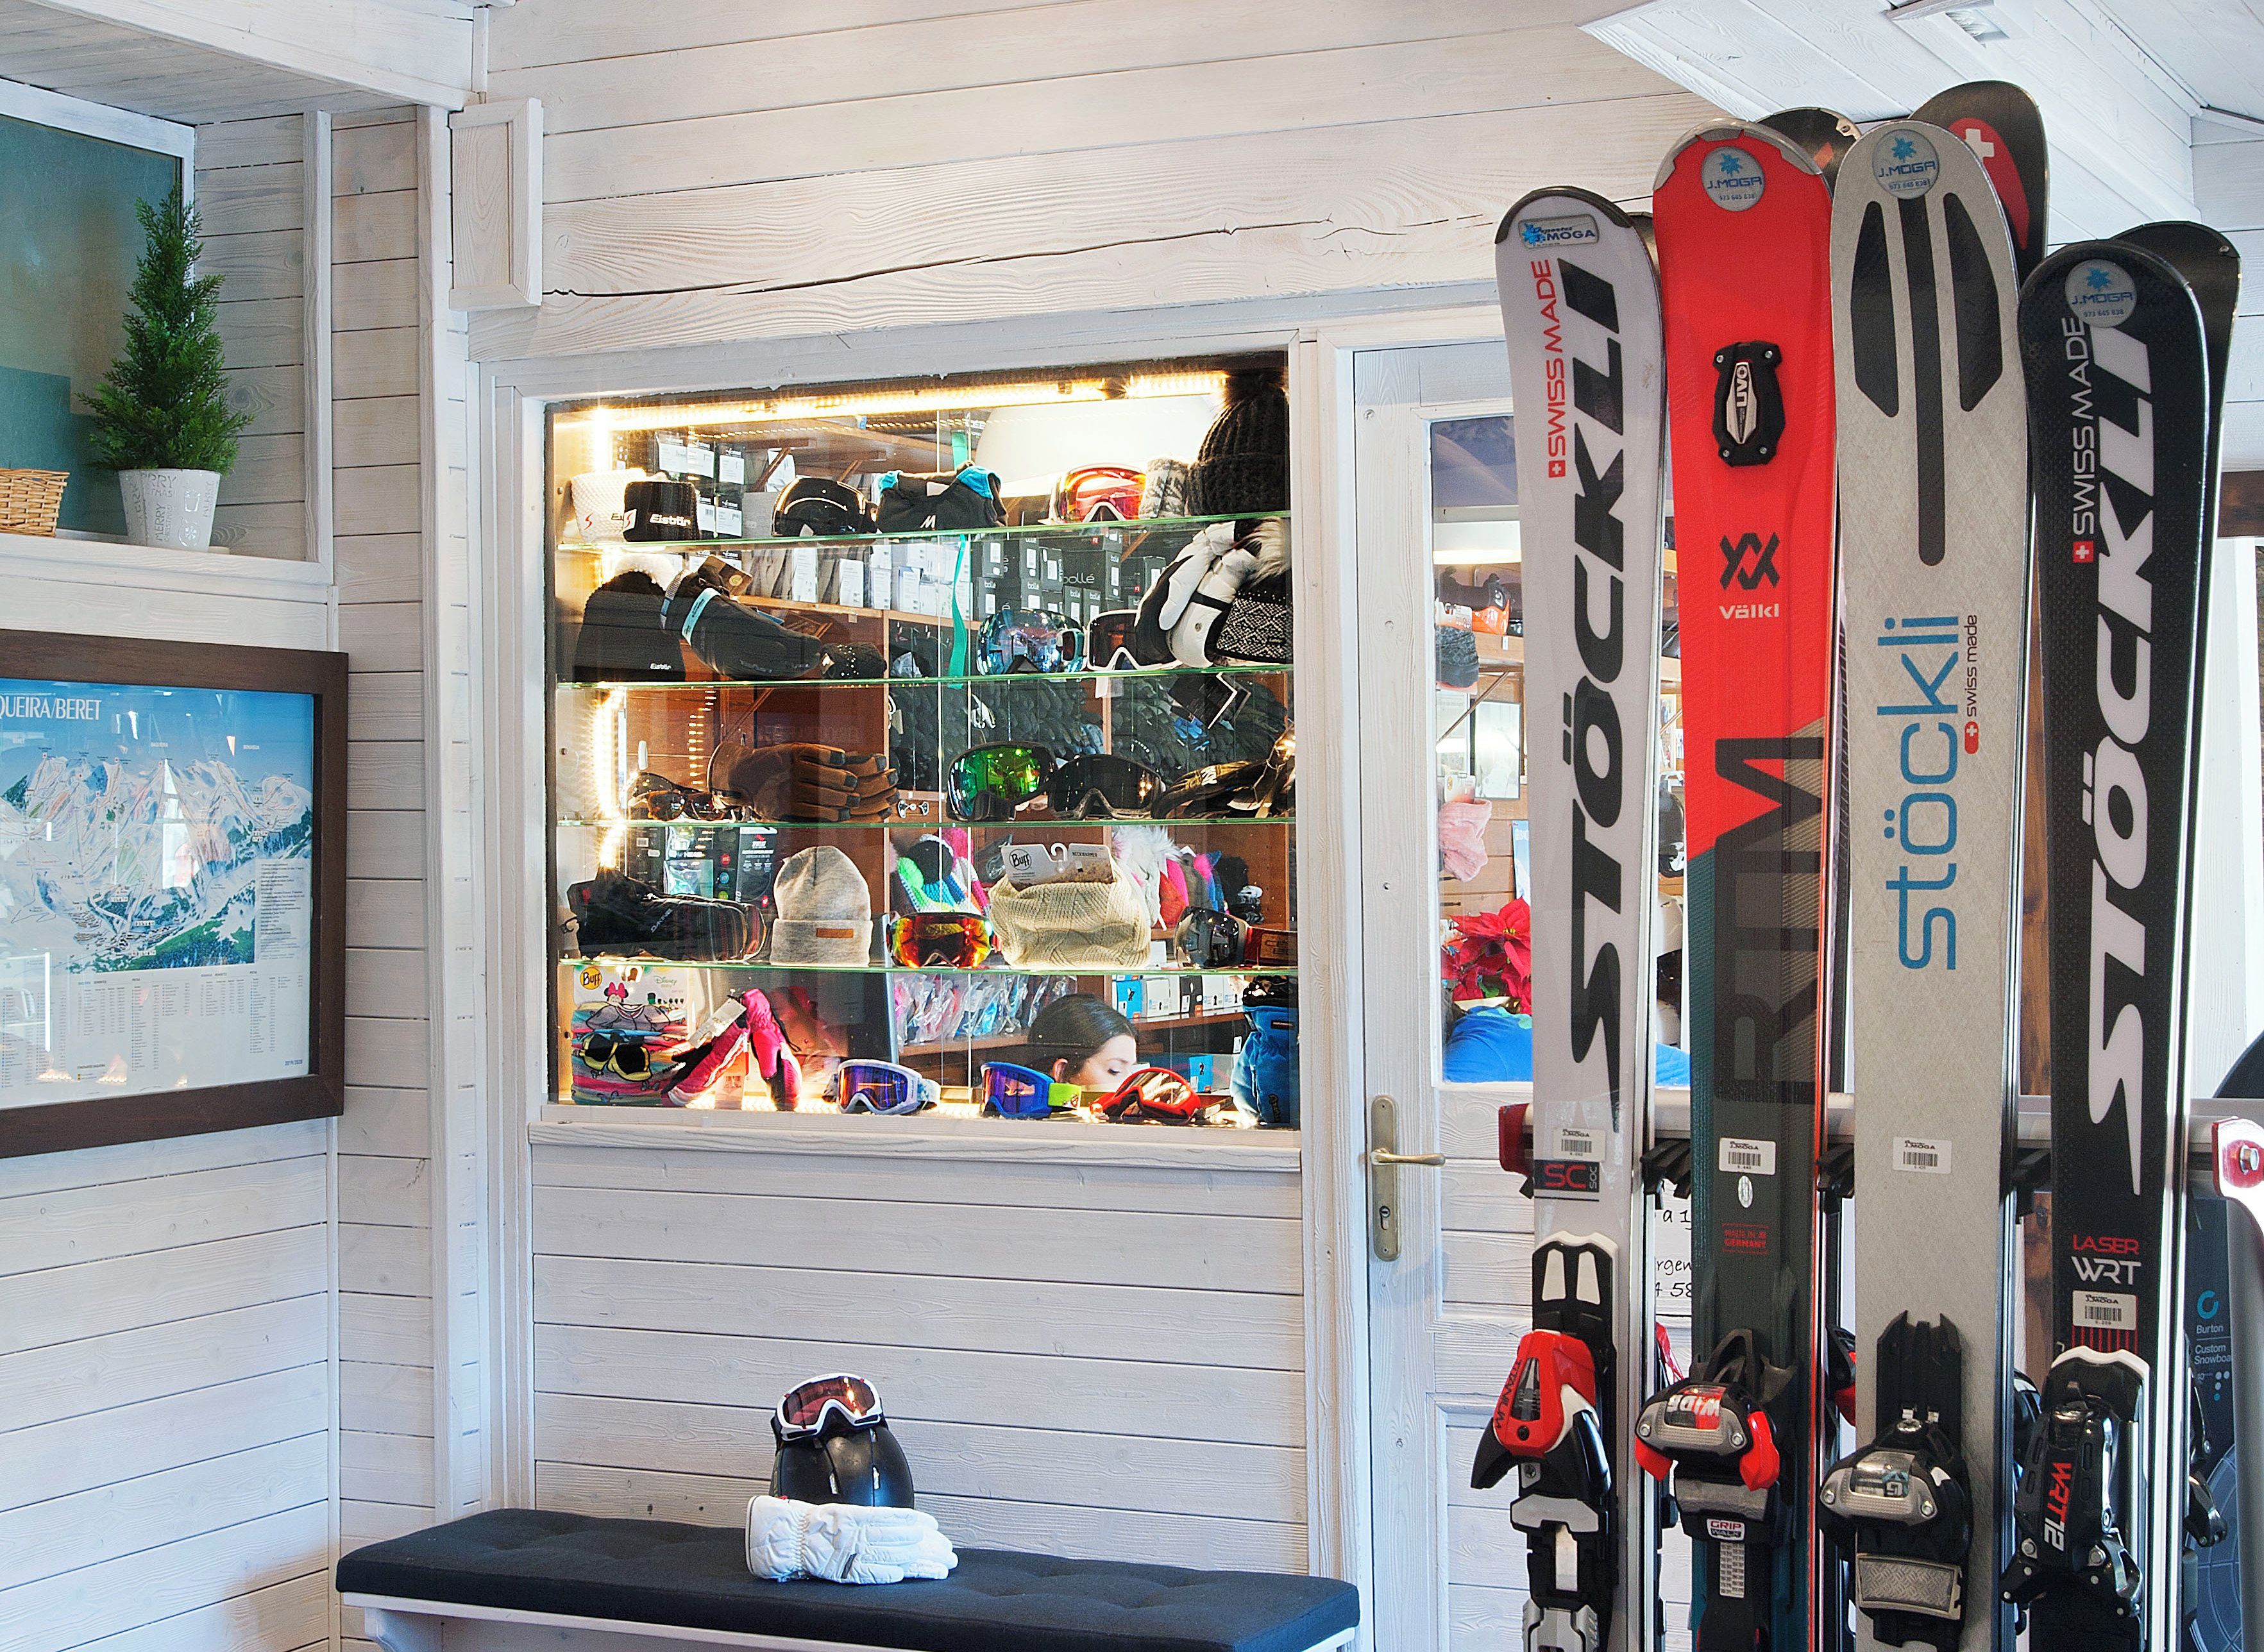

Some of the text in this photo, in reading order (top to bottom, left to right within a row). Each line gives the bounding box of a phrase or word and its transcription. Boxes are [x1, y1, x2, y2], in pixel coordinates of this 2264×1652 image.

[1707, 176, 1762, 189] J.MOGA
[1878, 161, 1936, 178] J.MOGA
[1531, 259, 1562, 353] MADE
[2072, 292, 2133, 305] J.MOGA
[1546, 358, 1566, 457] SWISS
[2063, 316, 2095, 535] SWISS MADE
[155, 503, 166, 541] MERRY
[1719, 603, 1779, 620] Völkl
[1964, 615, 1977, 716] swiss made
[1557, 258, 1624, 1133] STÖCKLI
[2082, 324, 2154, 1196] STÖCKLI
[1877, 616, 1959, 970] stöckli
[1544, 1163, 1598, 1190] SC SOC
[1724, 1238, 1766, 1248] GERMANY
[2073, 1235, 2140, 1255] LASER
[2071, 1256, 2142, 1285] WRT
[2196, 1324, 2224, 1334] Burton
[2195, 1344, 2226, 1354] Custom
[1496, 1360, 1521, 1429] TITANIUM
[1711, 1521, 1742, 1530] GRIP
